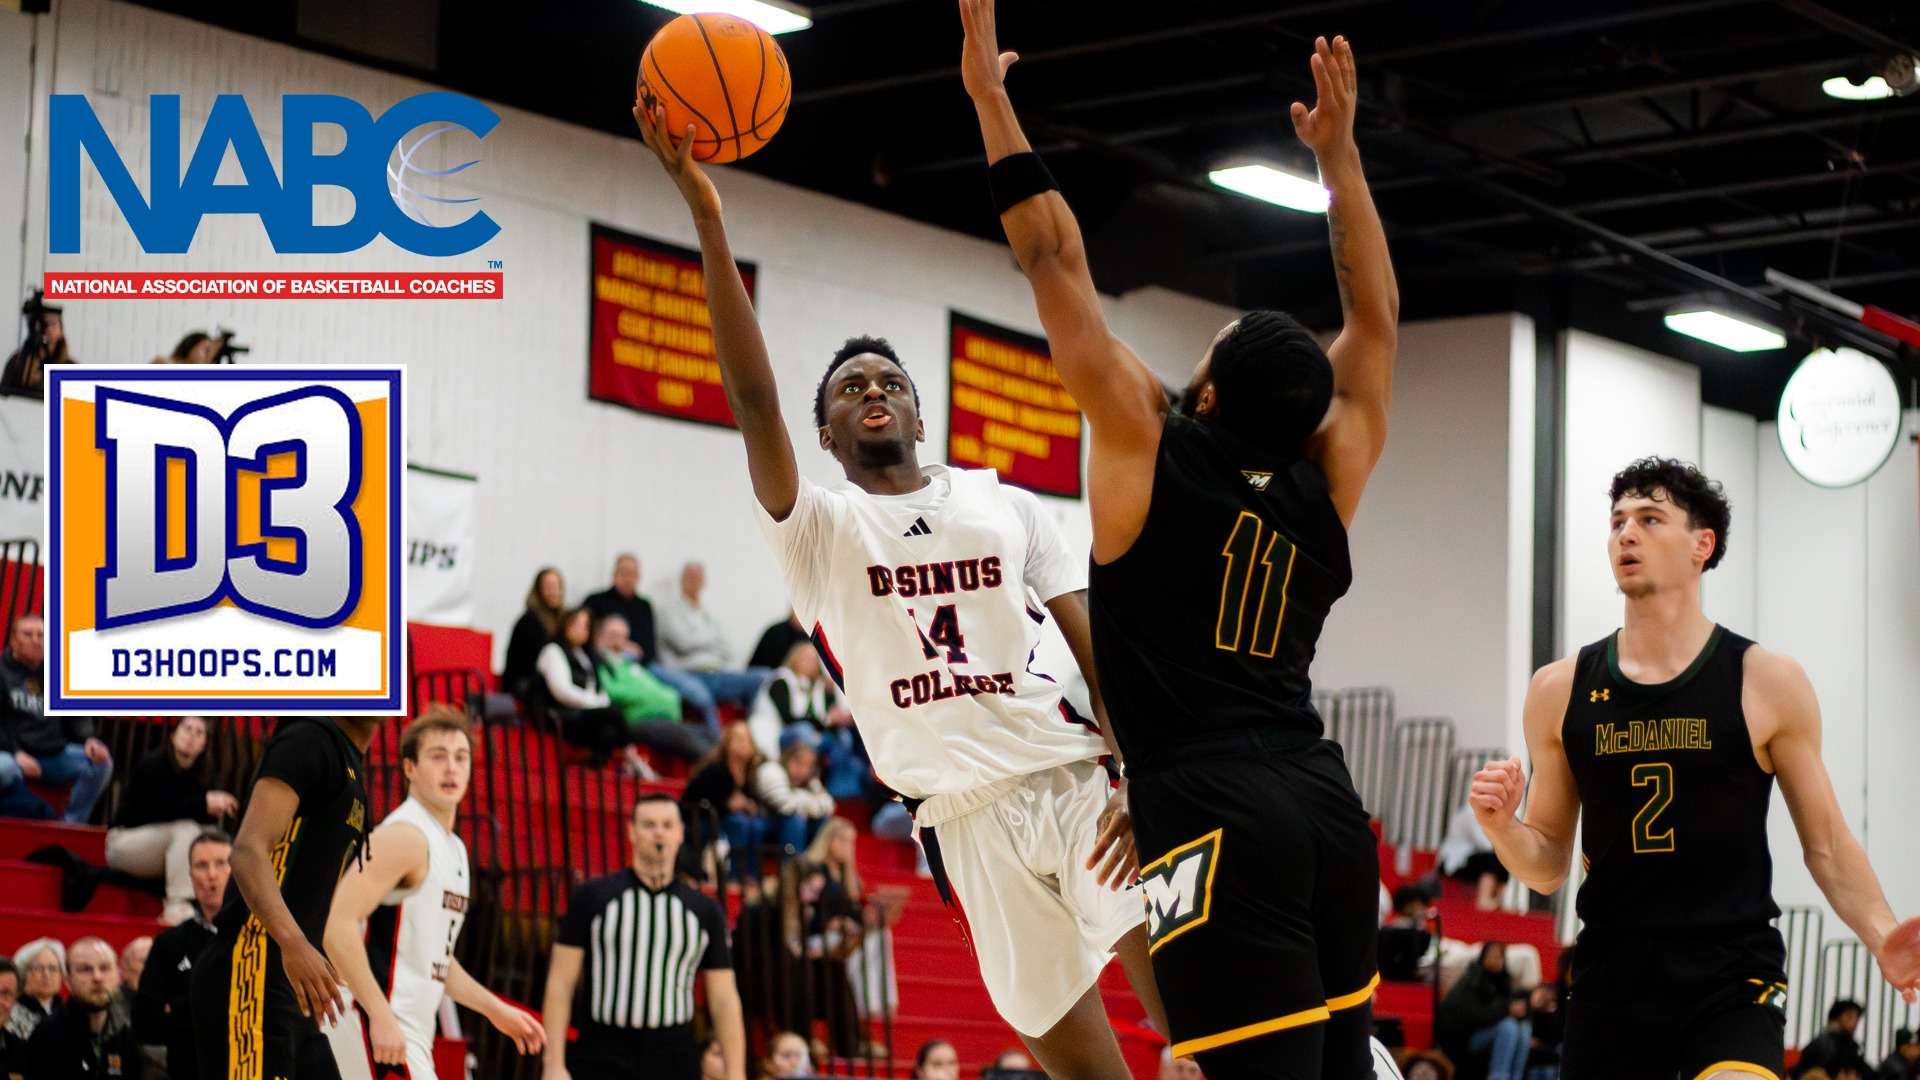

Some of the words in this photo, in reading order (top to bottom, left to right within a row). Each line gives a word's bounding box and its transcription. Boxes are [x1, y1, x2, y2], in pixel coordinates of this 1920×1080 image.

[867, 556, 1002, 598] URSINUS
[1216, 511, 1296, 659] 11
[1631, 762, 1674, 853] 2
